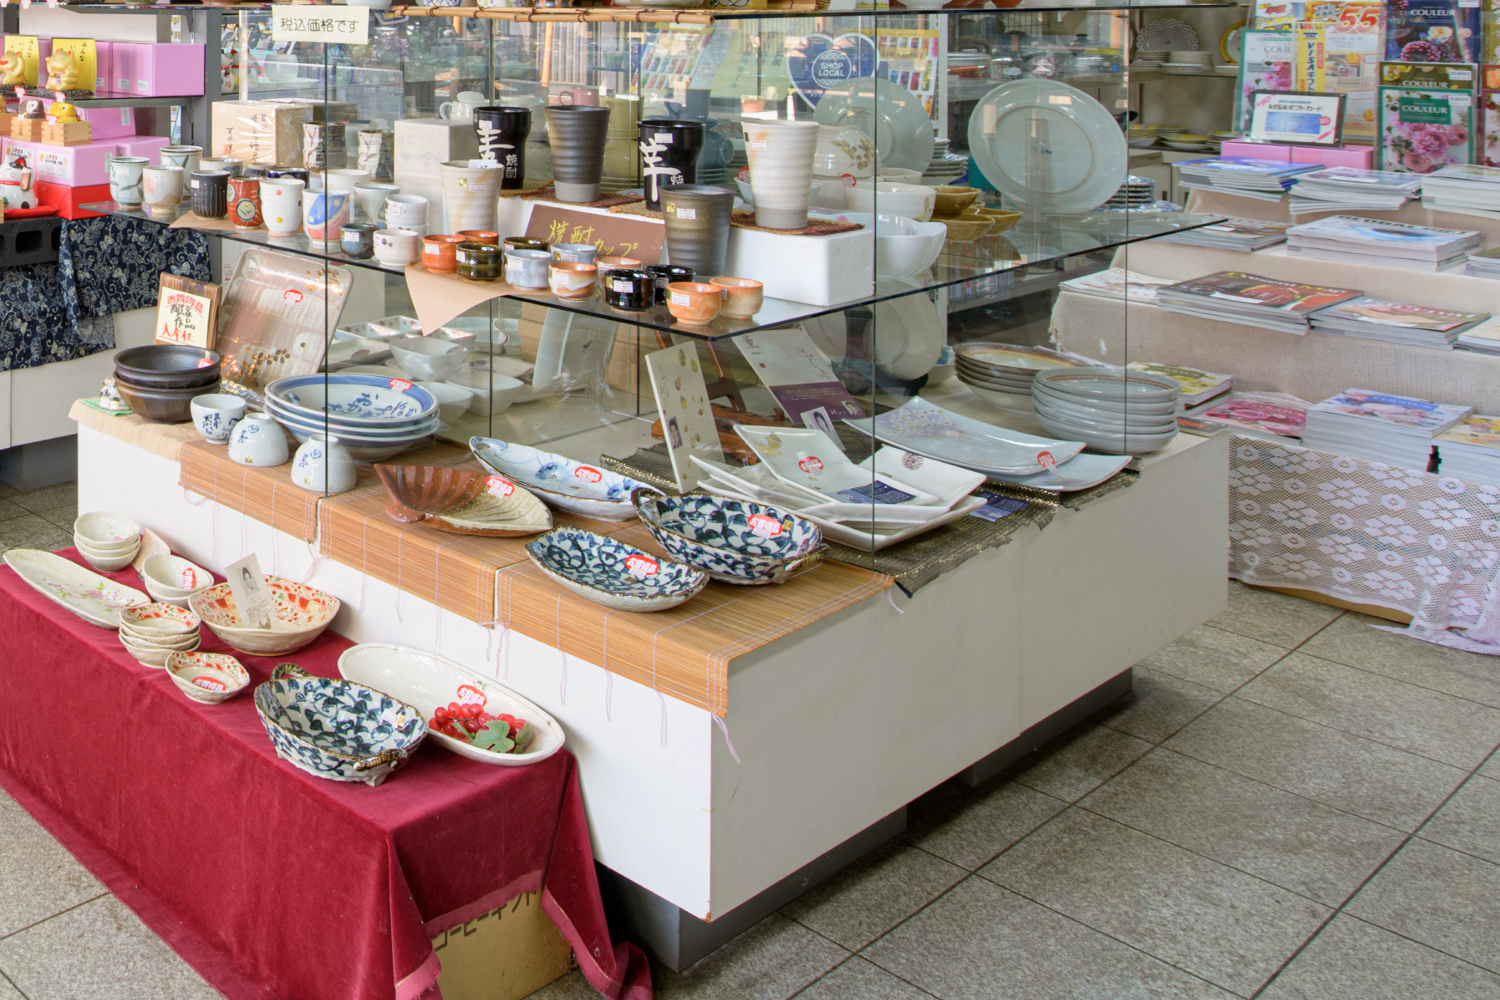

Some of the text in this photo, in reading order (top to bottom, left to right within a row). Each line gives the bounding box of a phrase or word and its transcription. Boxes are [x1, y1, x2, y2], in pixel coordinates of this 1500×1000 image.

[280, 18, 360, 33] 税込価格です
[1336, 6, 1381, 33] 55
[818, 69, 845, 77] LOCAL
[820, 62, 844, 70] SHOP
[1402, 80, 1449, 88] COULEUR
[1268, 104, 1323, 112] VISAギフトカード
[1402, 105, 1448, 114] COULEUR
[506, 153, 518, 179] 焼酎
[549, 220, 639, 257] 焼酎カップ
[167, 294, 203, 314] お買得品
[749, 517, 780, 534] お買得品
[194, 677, 223, 691] お買得品
